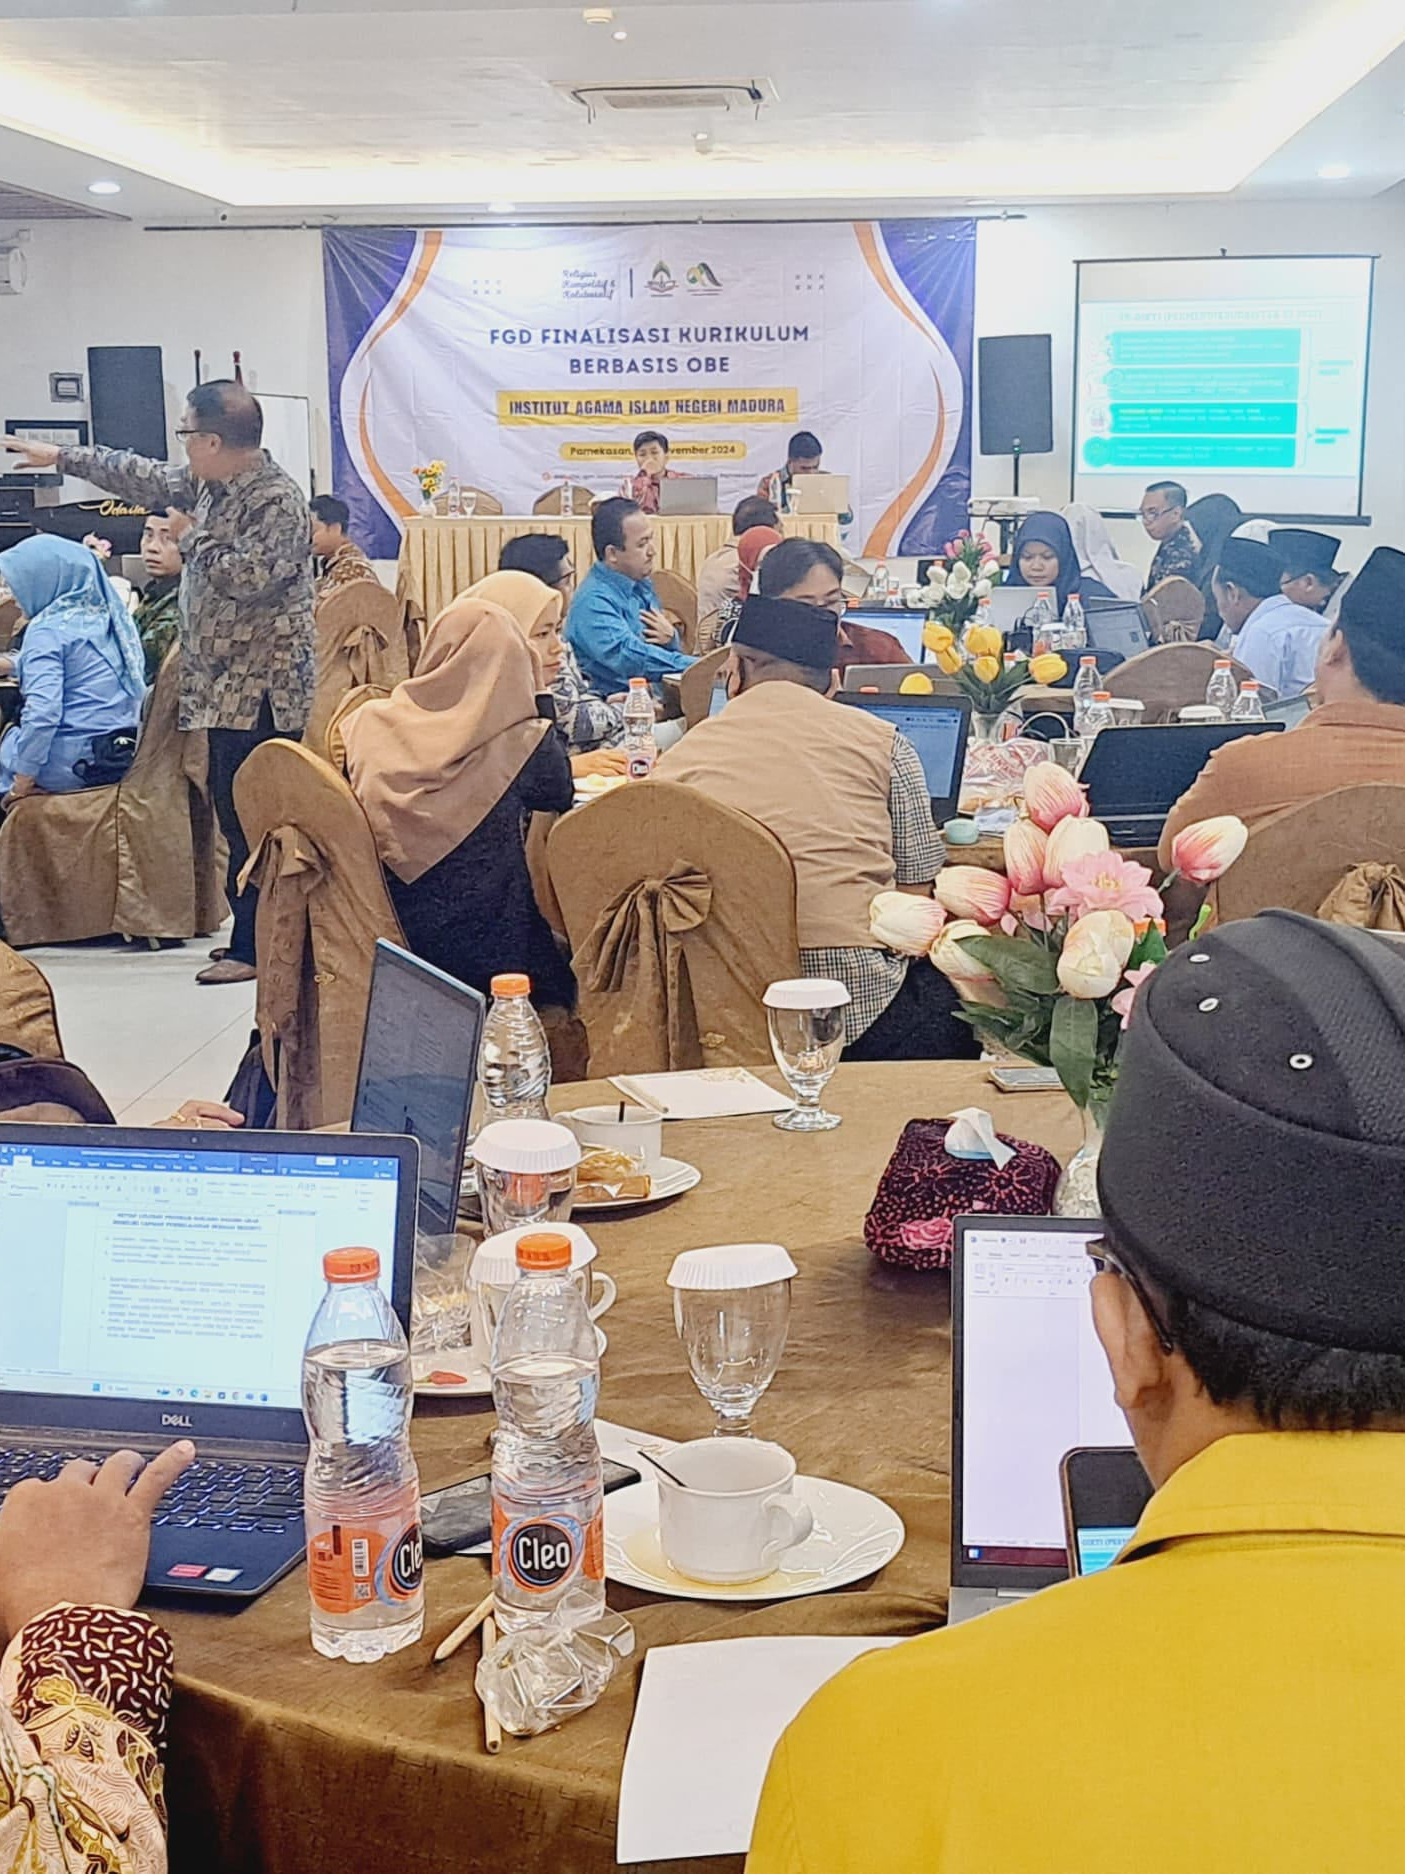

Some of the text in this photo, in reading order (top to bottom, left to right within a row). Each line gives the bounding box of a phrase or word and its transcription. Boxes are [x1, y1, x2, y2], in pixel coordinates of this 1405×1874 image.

[489, 325, 809, 345] FGD FINALISASI KURIKULUM
[569, 356, 731, 374] BERBASIS OBE
[508, 398, 786, 416] INSTITUT AGAMA ISLAM NEGERI MADURA
[570, 445, 736, 457] Pamekasan, vember 2024
[161, 1414, 193, 1428] DELL
[399, 1540, 423, 1578] Cle
[518, 1536, 571, 1570] Cleo
